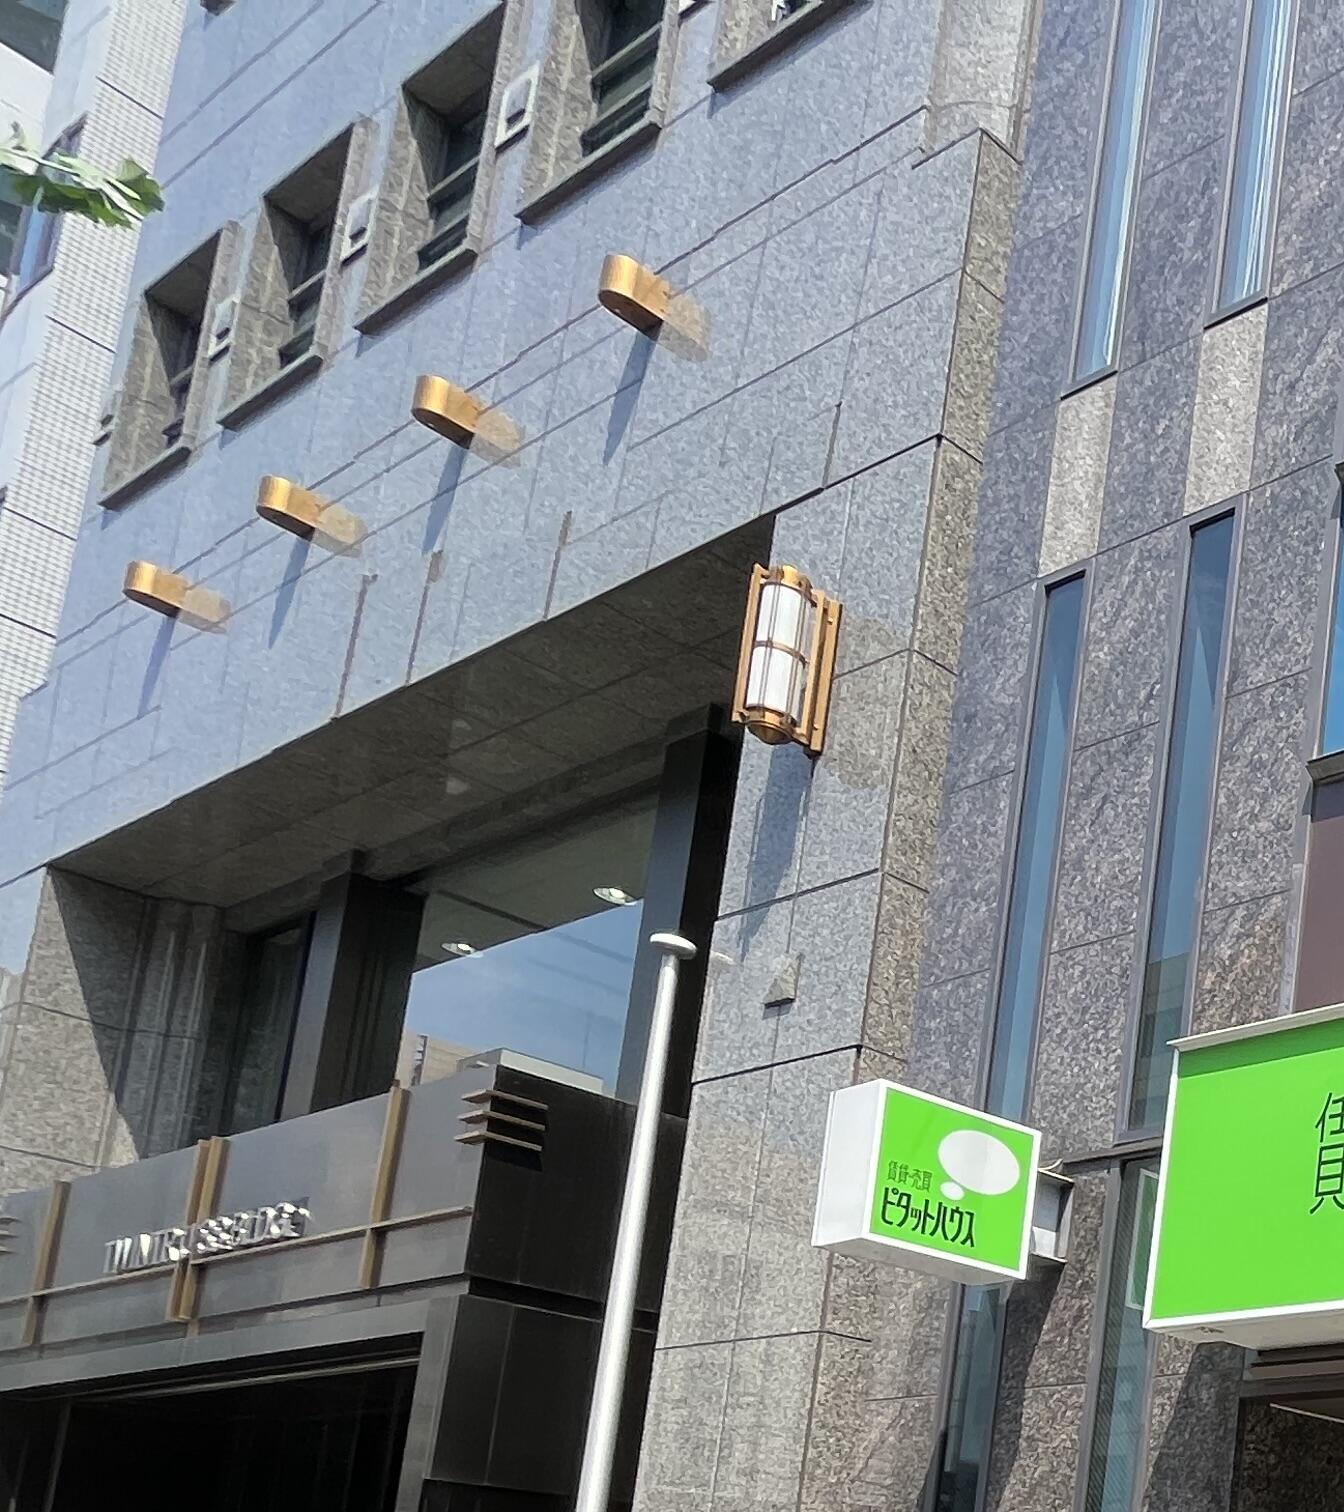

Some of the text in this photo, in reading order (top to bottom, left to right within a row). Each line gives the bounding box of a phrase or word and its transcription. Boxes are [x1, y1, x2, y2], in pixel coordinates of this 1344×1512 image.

[880, 1186, 976, 1249] ピタットハウス
